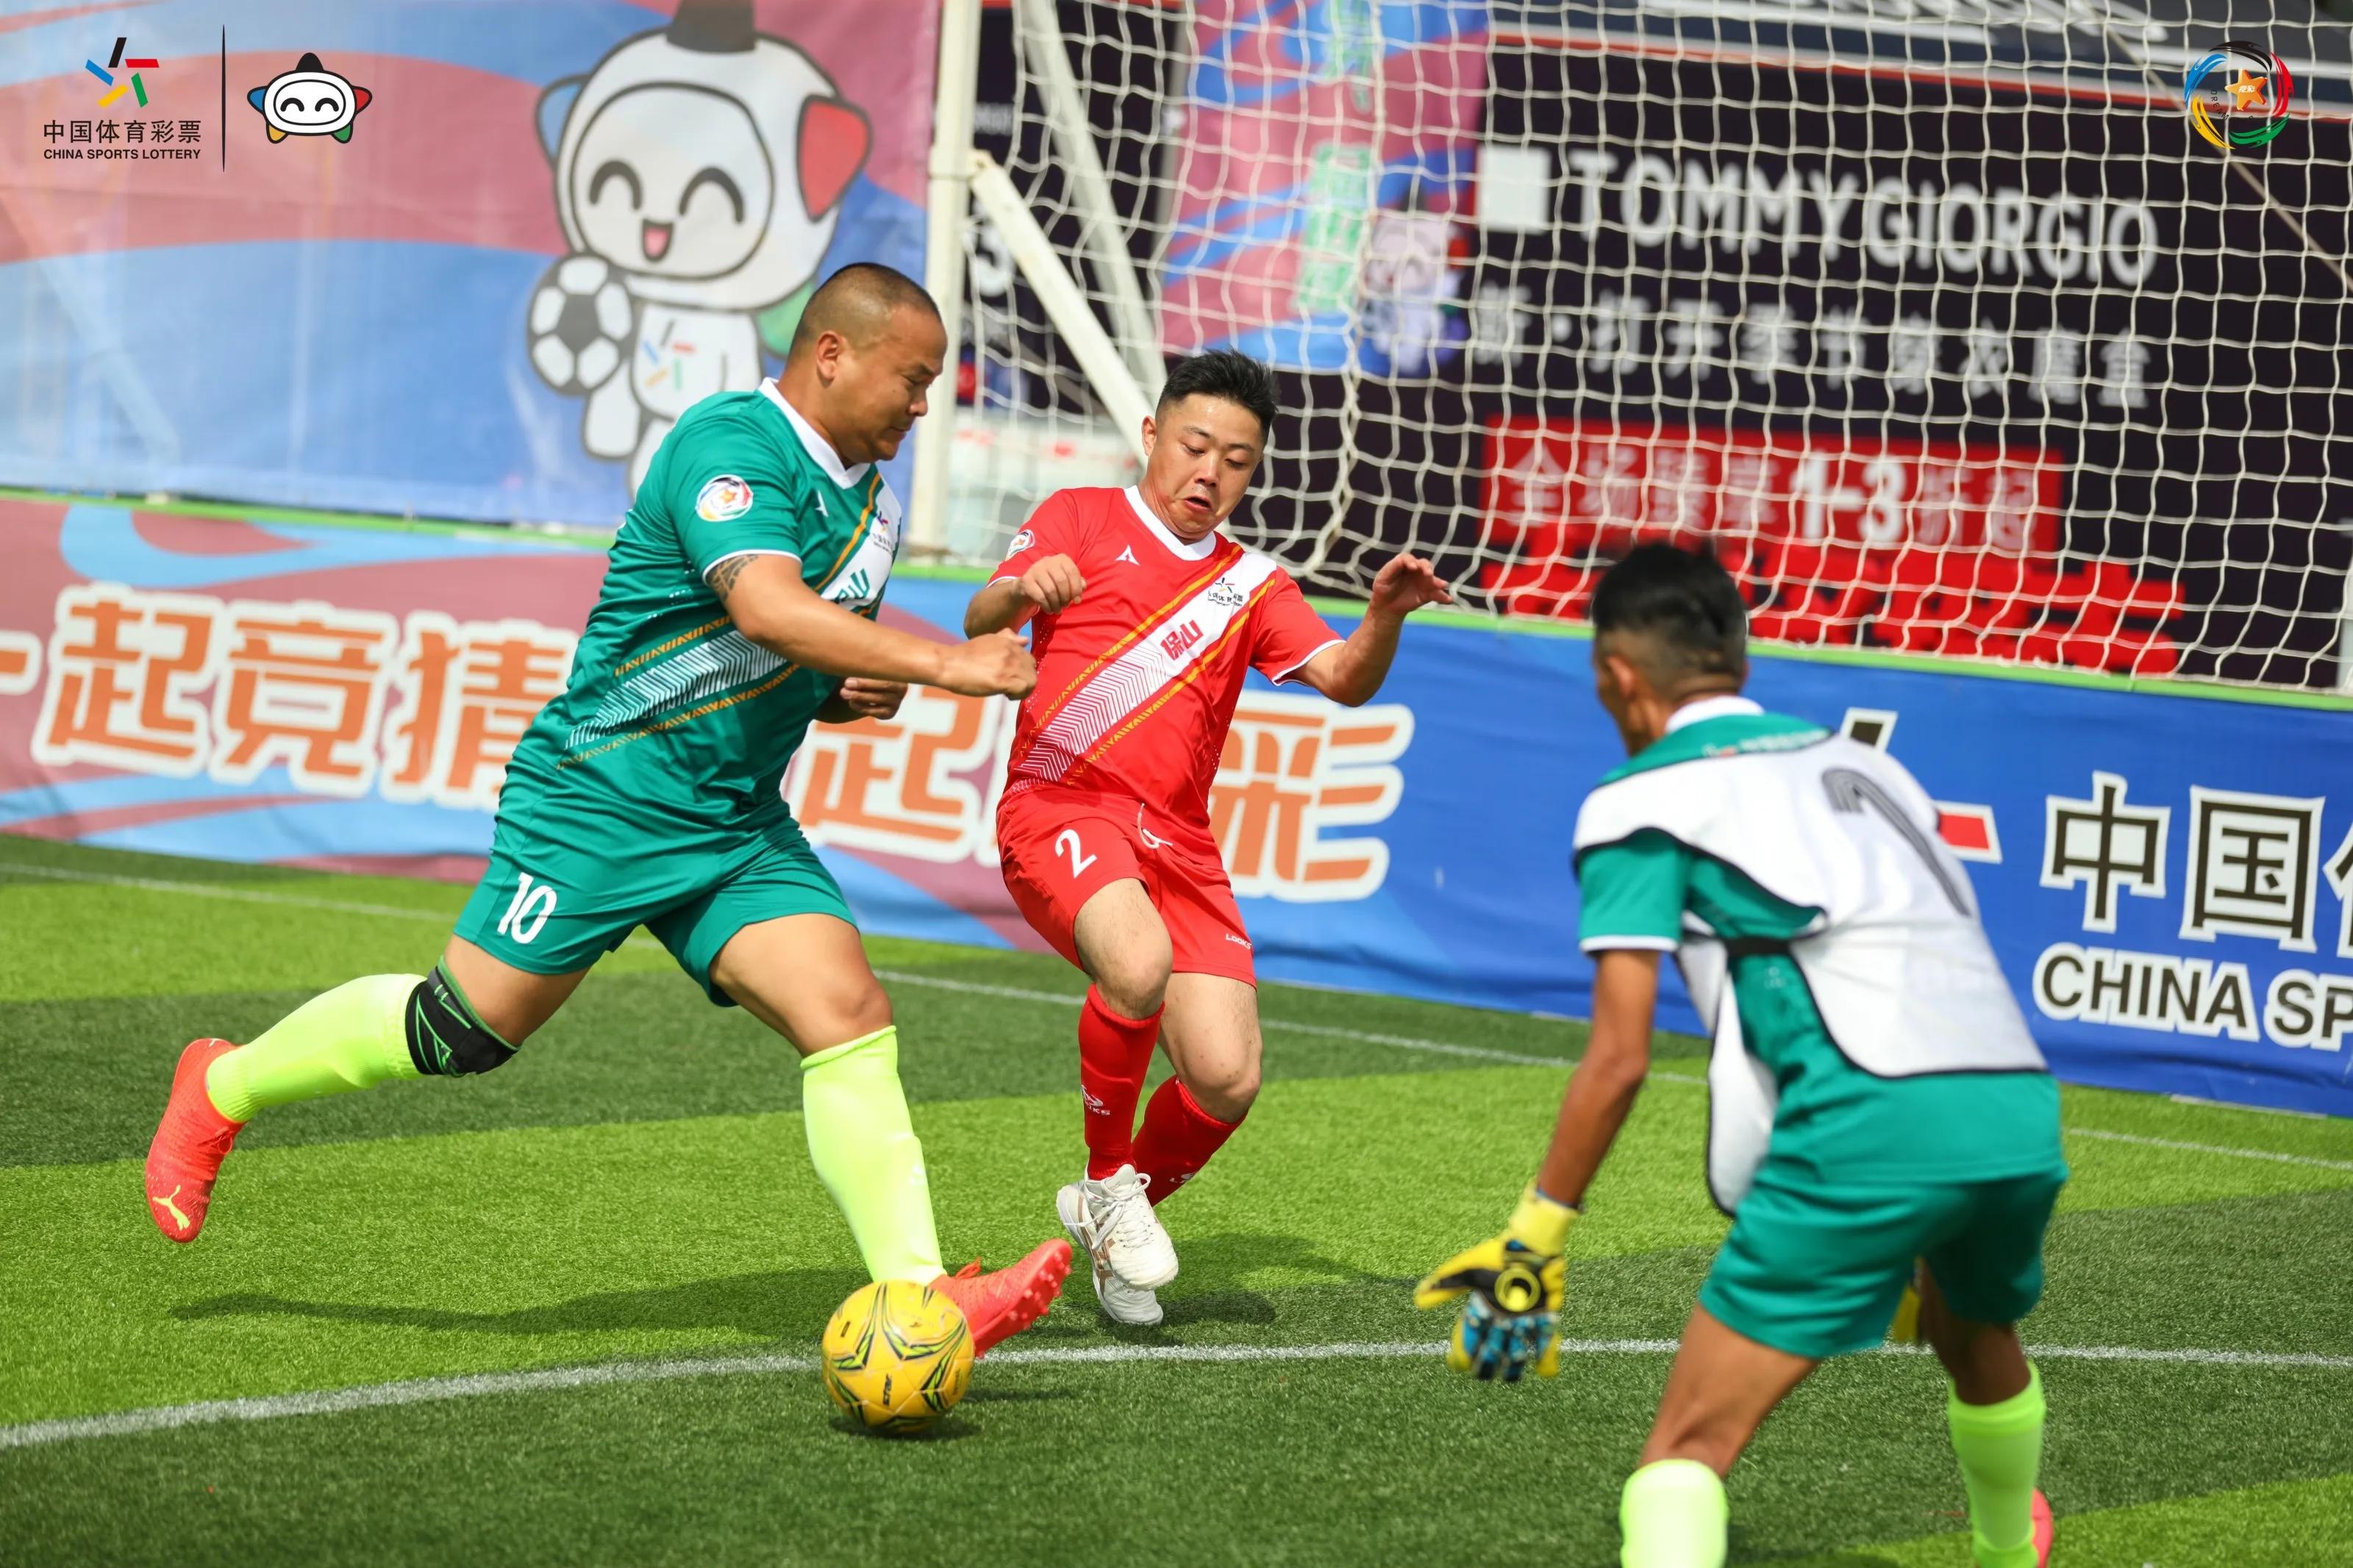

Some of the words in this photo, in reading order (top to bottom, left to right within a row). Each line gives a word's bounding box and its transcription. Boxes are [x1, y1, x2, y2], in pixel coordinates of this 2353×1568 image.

[1160, 619, 1204, 661] 保山
[0, 590, 577, 806] 起竞猜
[1054, 828, 1097, 878] 2
[497, 872, 557, 944] 10
[2036, 946, 2256, 1038] CHINA
